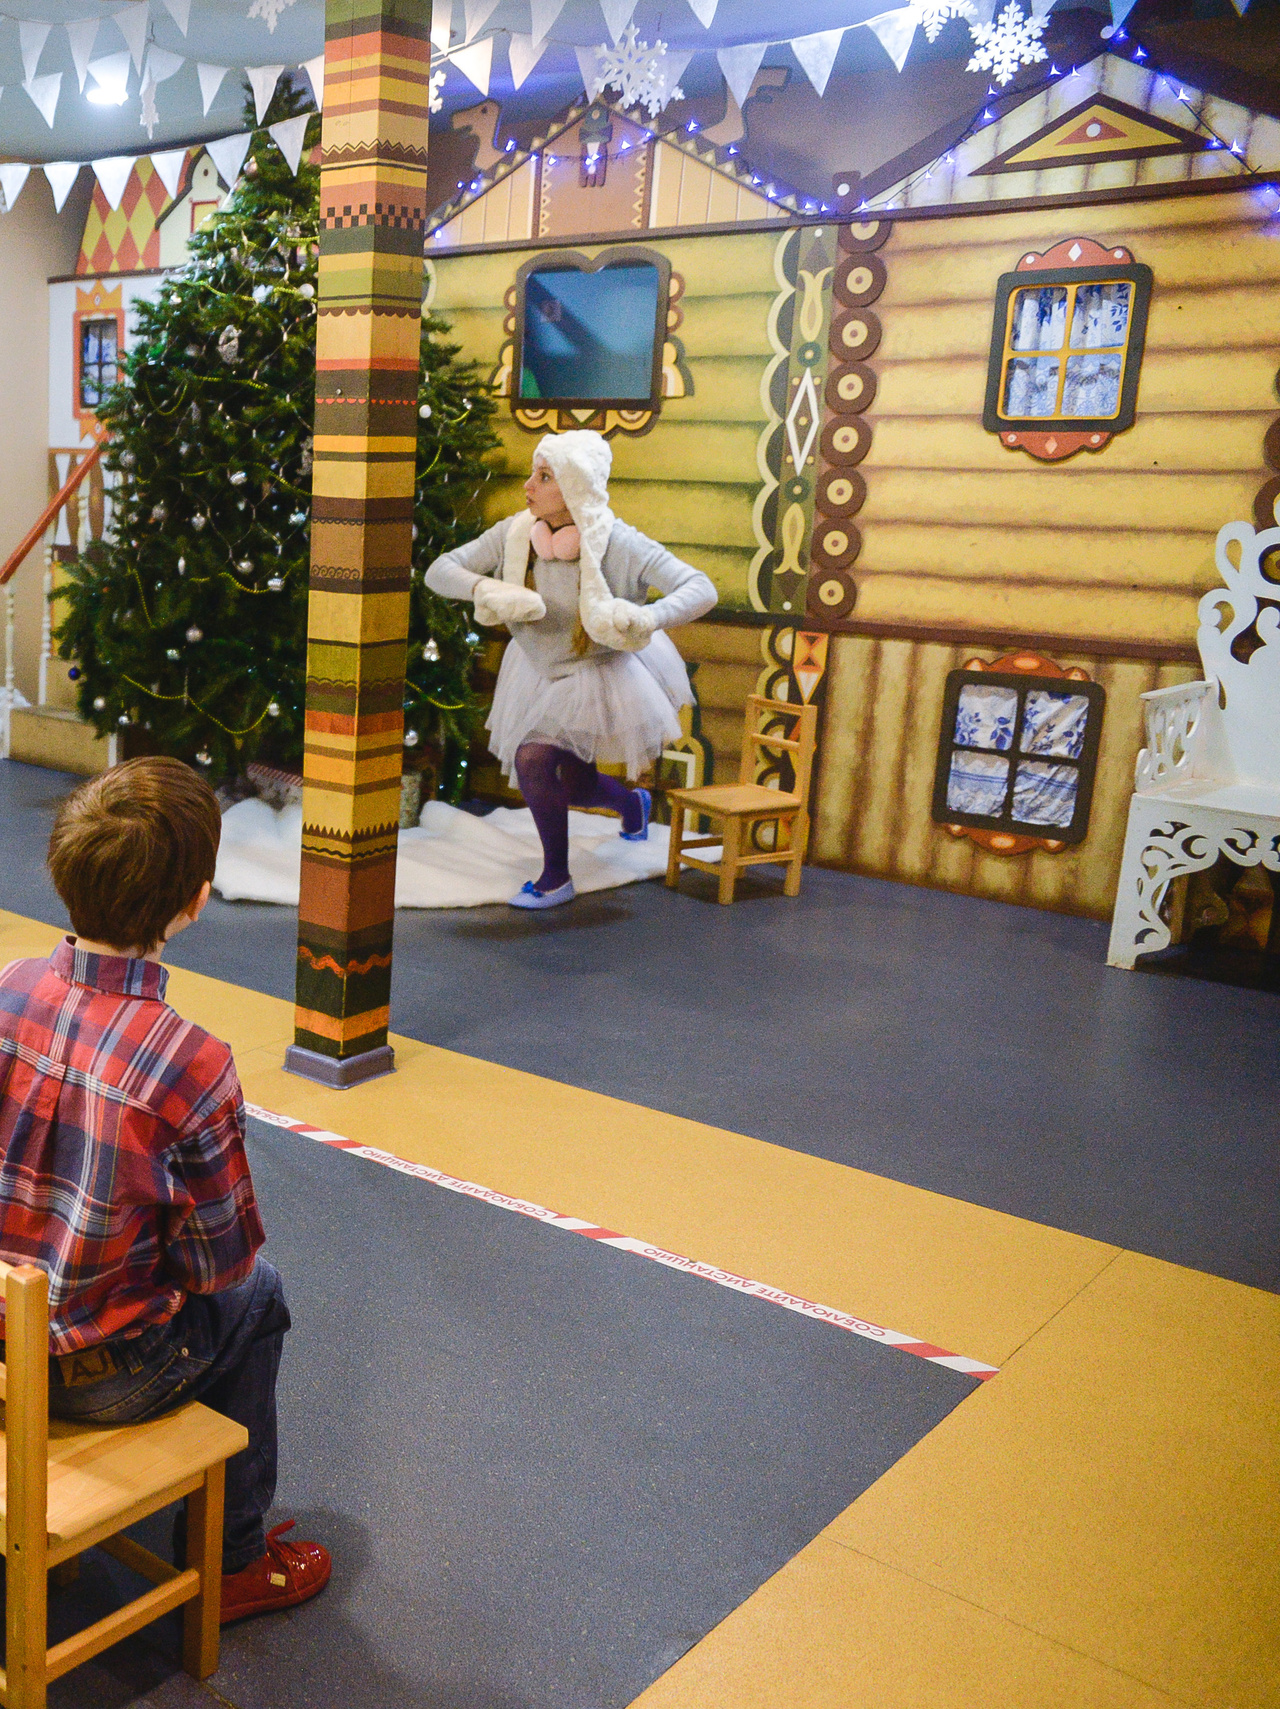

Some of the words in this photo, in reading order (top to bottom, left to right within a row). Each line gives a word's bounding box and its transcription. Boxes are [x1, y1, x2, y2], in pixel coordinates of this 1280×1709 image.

[361, 1149, 449, 1182] ДИСТАНЦИЮ
[448, 1179, 548, 1217] СОБЛЮДАЙТЕ
[643, 1247, 756, 1289] ДИСТАНЦИЮ
[756, 1286, 887, 1338] СОБЛЮДАЙТЕ
